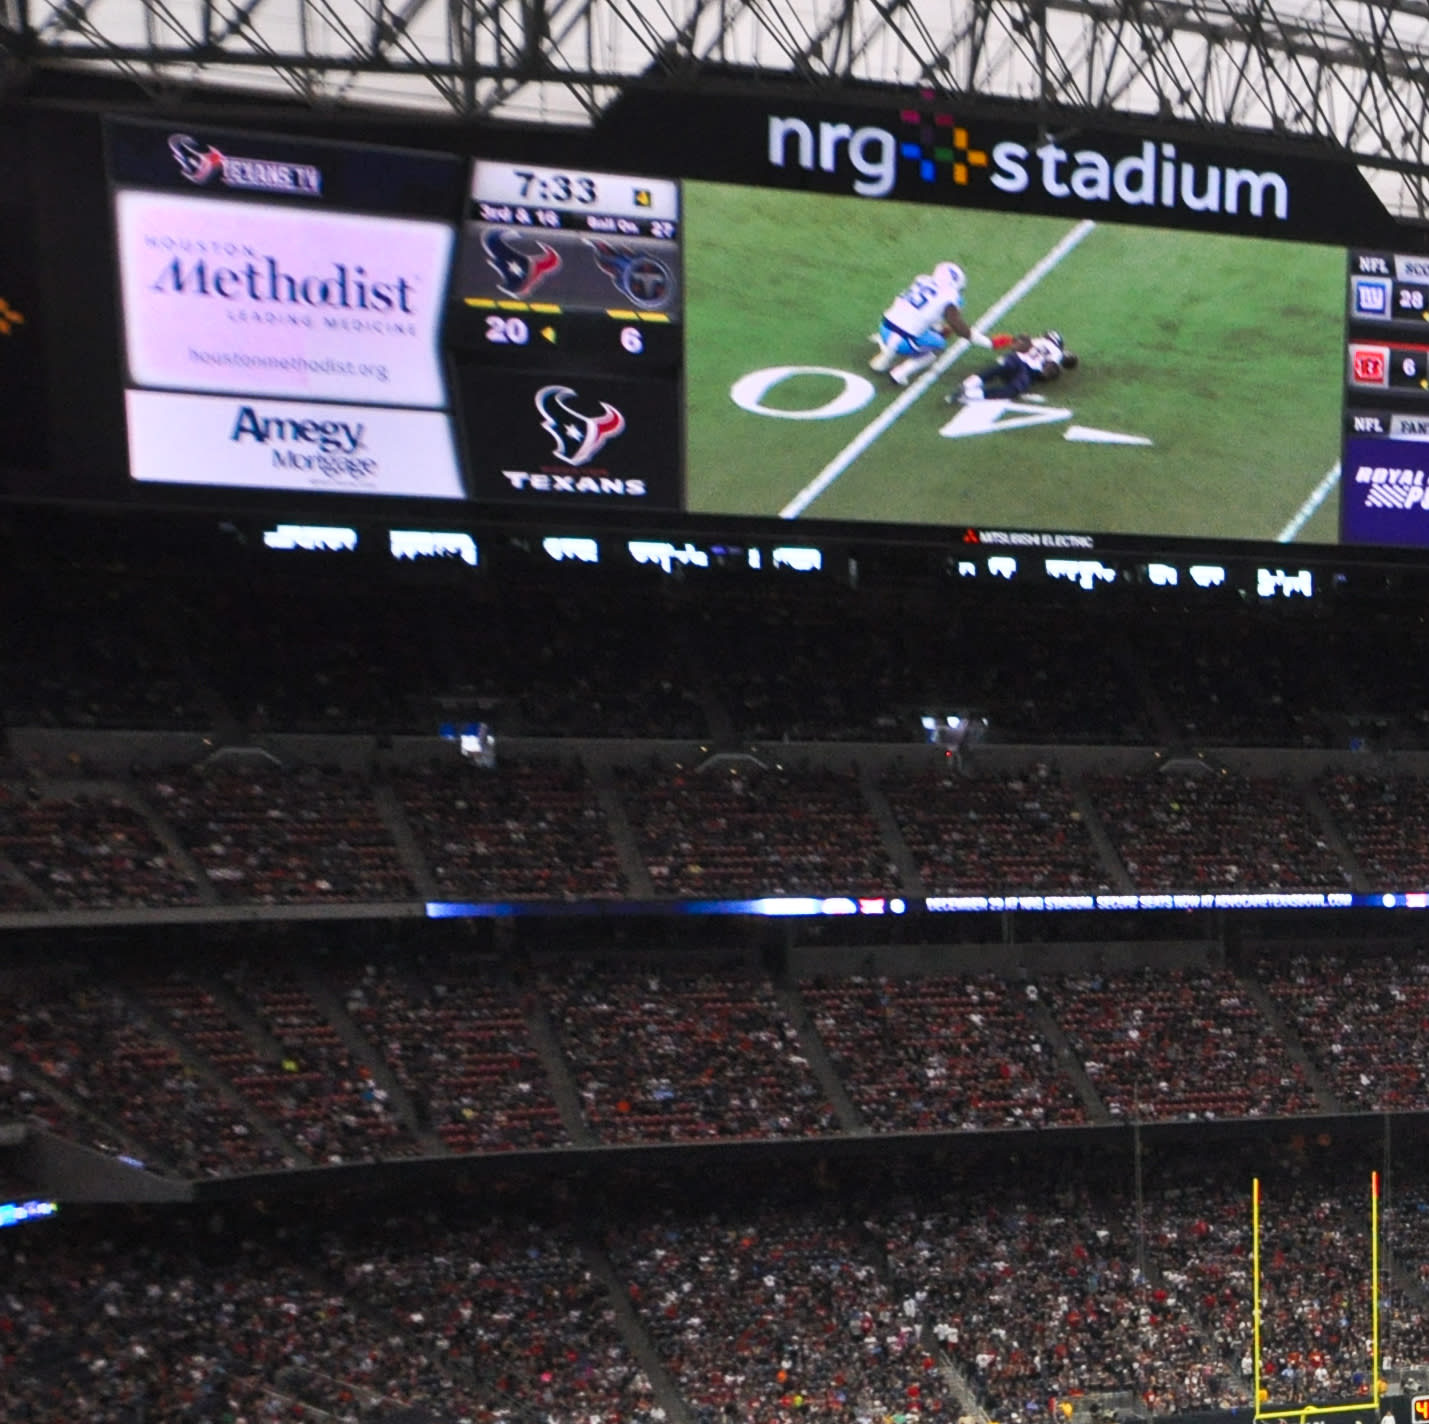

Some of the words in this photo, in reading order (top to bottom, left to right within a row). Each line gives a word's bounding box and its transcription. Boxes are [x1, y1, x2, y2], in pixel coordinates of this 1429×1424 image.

[767, 113, 897, 198] nrg
[989, 134, 1289, 221] stadium
[514, 169, 597, 205] 7:33
[143, 234, 256, 256] HOUSTON
[1359, 256, 1389, 275] NFL
[150, 256, 413, 315] Methodist
[324, 316, 417, 337] MEDICINE
[485, 315, 529, 345] 20
[620, 326, 643, 354] 6
[187, 348, 389, 382] houstonmethodist.org
[1402, 357, 1416, 377] 6
[229, 404, 366, 453] Amegy
[1353, 416, 1384, 433] NFL
[271, 448, 379, 479] Mortgage
[1355, 465, 1425, 487] ROYAL
[501, 469, 648, 497] TEXANS
